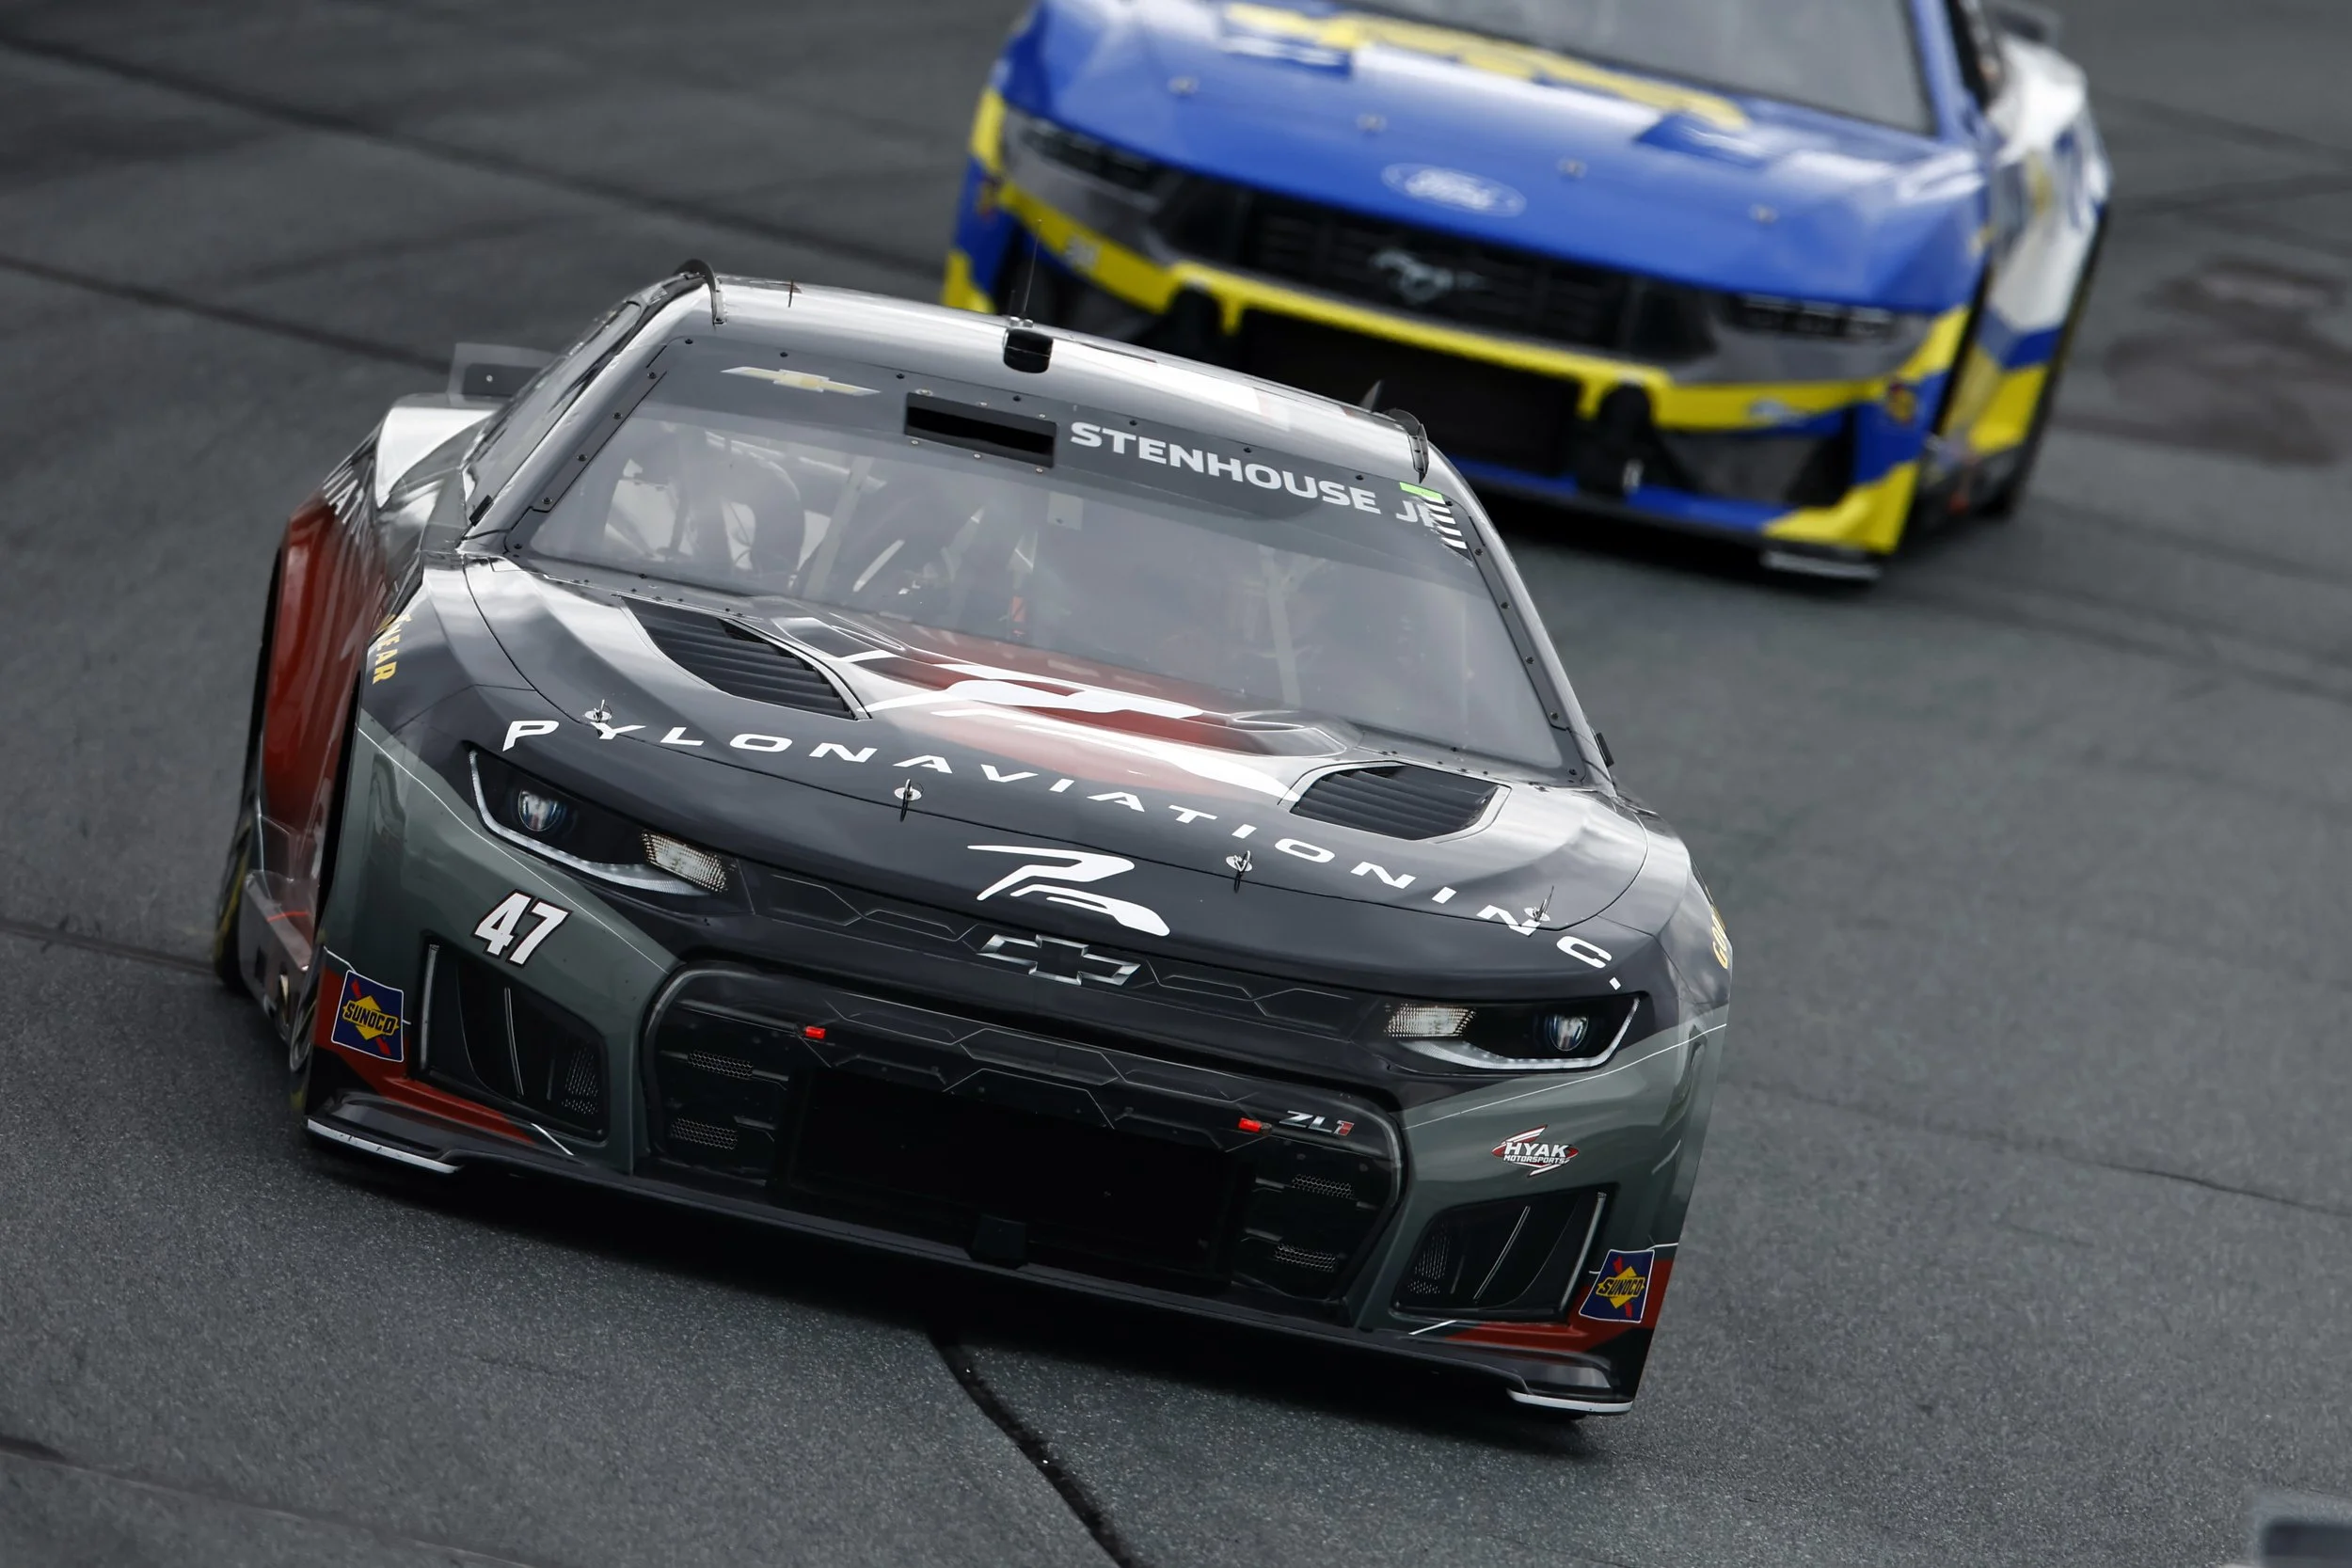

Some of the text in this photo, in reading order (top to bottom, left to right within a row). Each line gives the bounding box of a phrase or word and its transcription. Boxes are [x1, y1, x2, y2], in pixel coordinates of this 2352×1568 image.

[1070, 420, 1382, 515] STENHOUSE
[472, 890, 571, 967] 47
[344, 1003, 396, 1034] SUNOCO
[1279, 1110, 1355, 1136] ZL1
[1503, 1154, 1566, 1164] MOTORSPORTS
[1504, 1142, 1570, 1158] HYAK
[1599, 1278, 1645, 1297] SUNOCO
